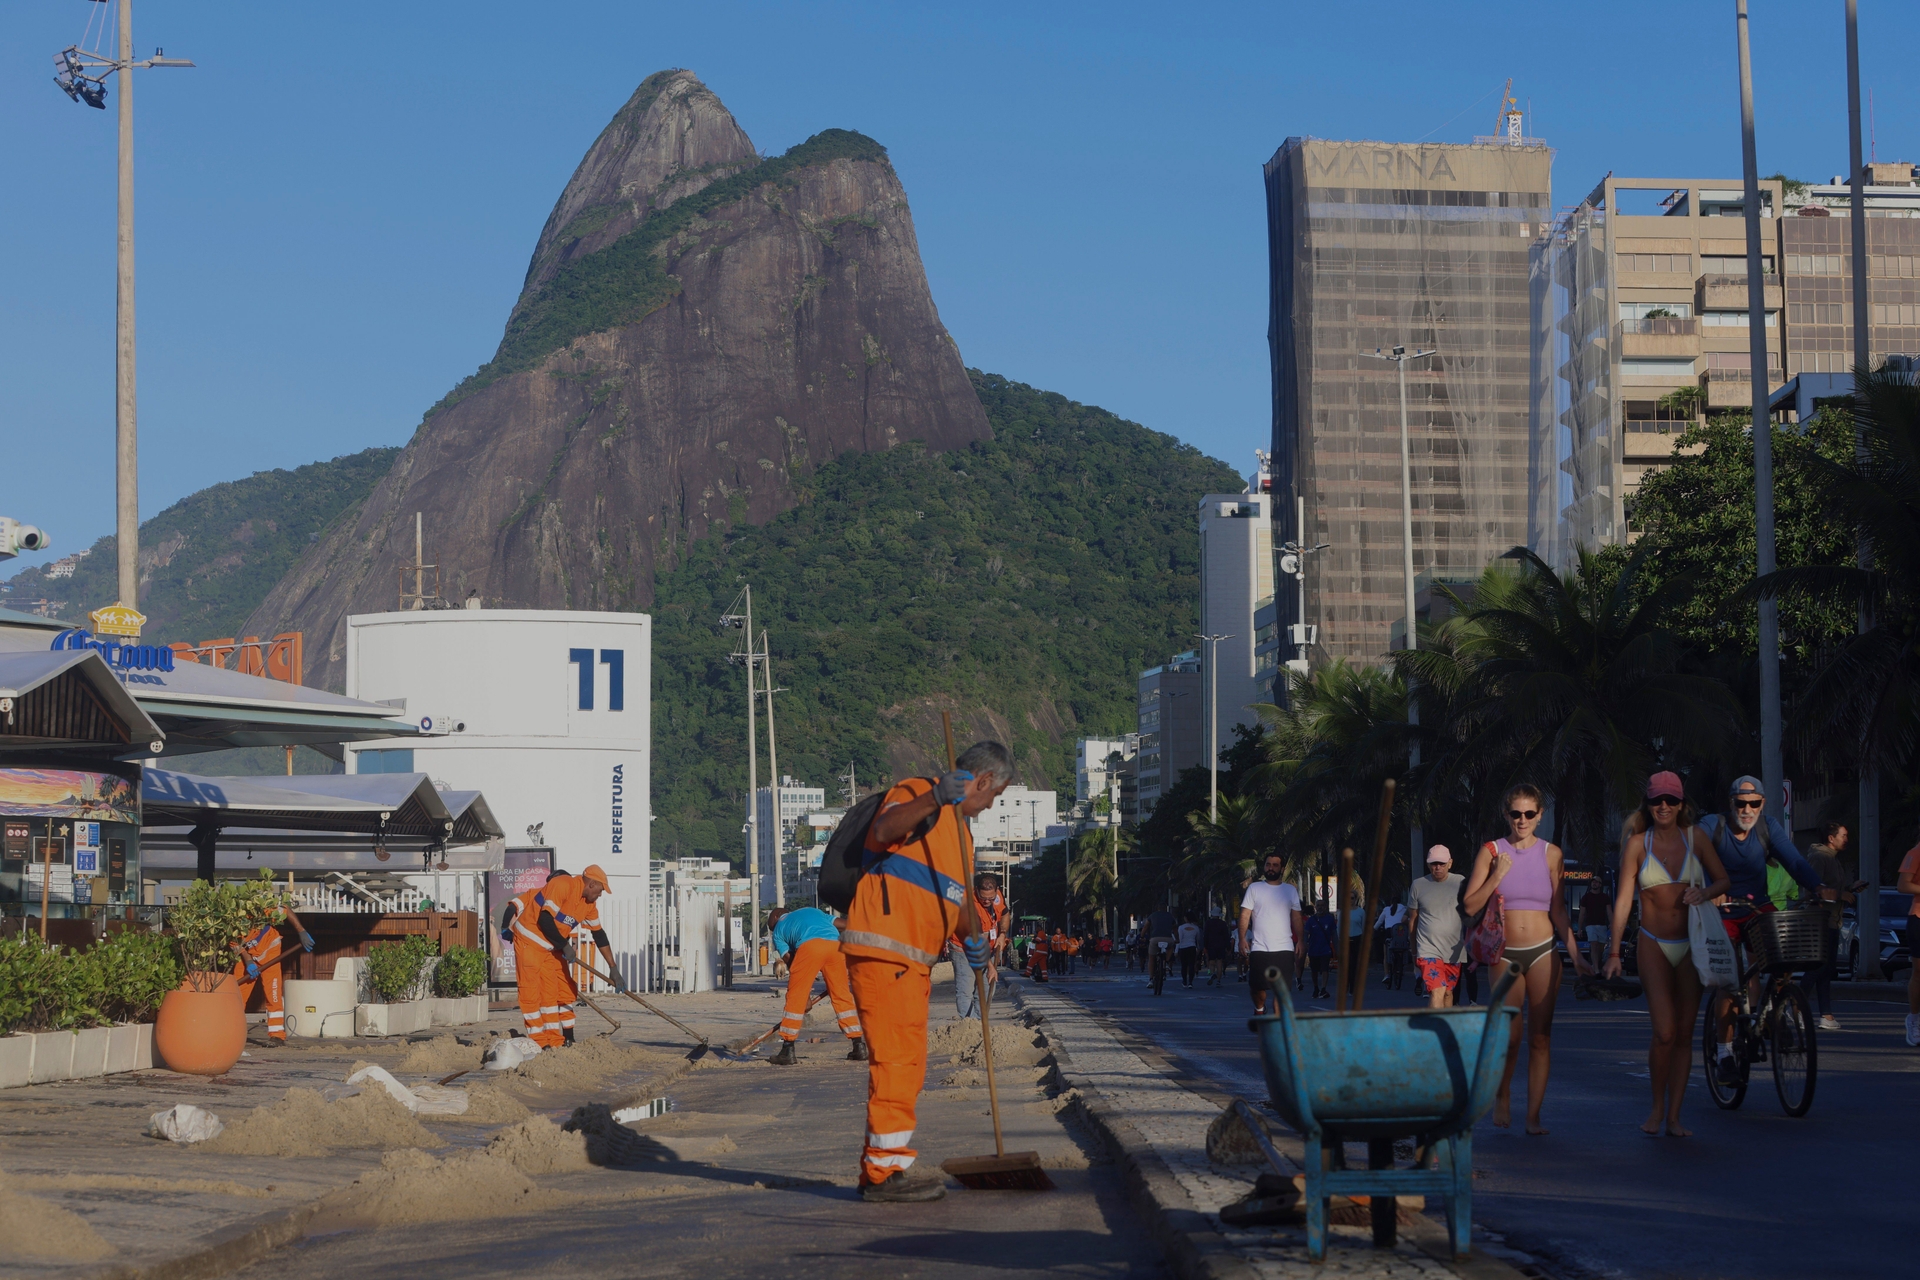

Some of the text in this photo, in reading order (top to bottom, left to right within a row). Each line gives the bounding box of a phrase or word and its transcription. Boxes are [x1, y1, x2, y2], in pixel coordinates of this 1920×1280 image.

[1310, 149, 1457, 182] MARINA
[50, 629, 176, 673] Corona
[569, 648, 624, 711] 11
[612, 763, 624, 854] PREFEITURA
